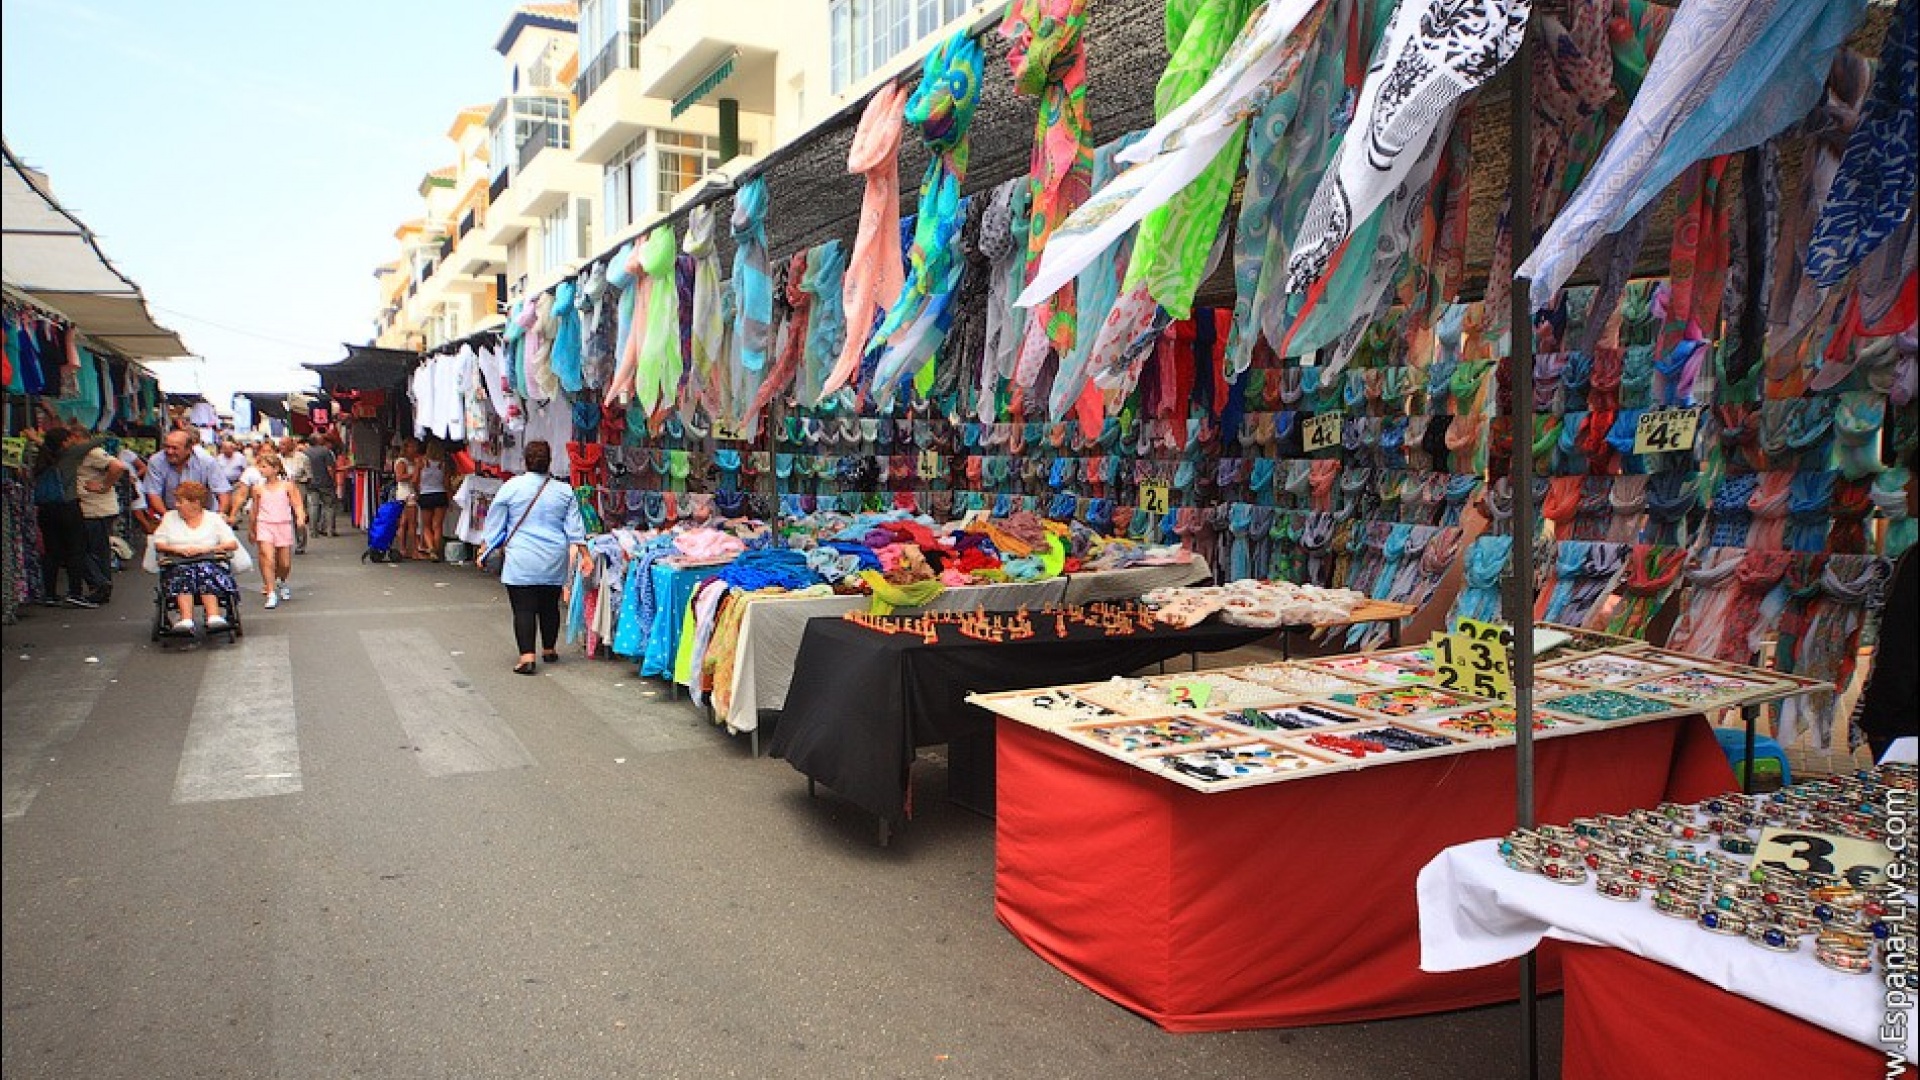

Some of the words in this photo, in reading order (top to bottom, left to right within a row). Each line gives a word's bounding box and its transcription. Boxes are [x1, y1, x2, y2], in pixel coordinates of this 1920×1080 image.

[1640, 410, 1696, 423] OFERTA
[1437, 637, 1452, 664] 1
[1438, 666, 1460, 690] 2
